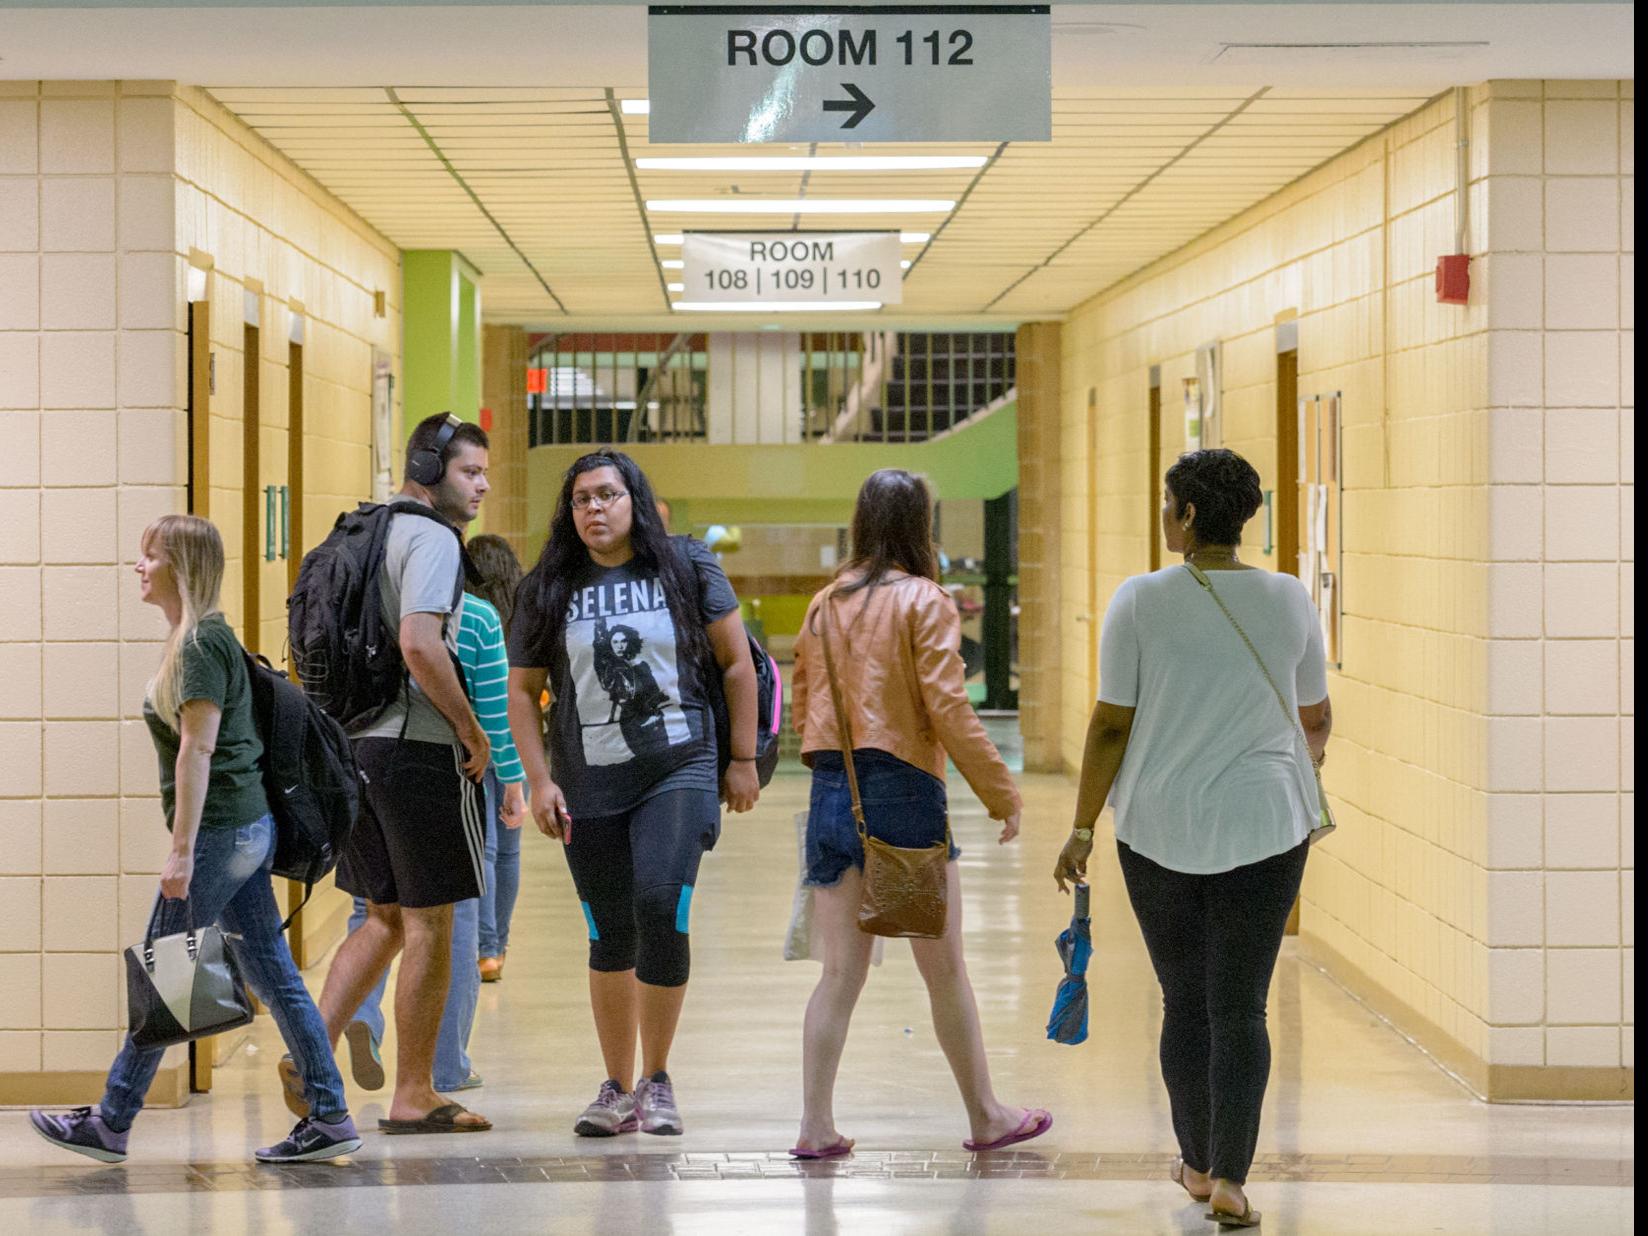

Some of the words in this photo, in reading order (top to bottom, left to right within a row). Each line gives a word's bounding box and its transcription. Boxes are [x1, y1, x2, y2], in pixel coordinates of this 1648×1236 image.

[727, 29, 877, 67] ROOM
[896, 29, 974, 66] 112
[750, 241, 834, 262] ROOM
[704, 269, 748, 290] 108
[771, 269, 814, 290] 109
[837, 268, 881, 289] 110
[565, 577, 667, 623] SELENA
